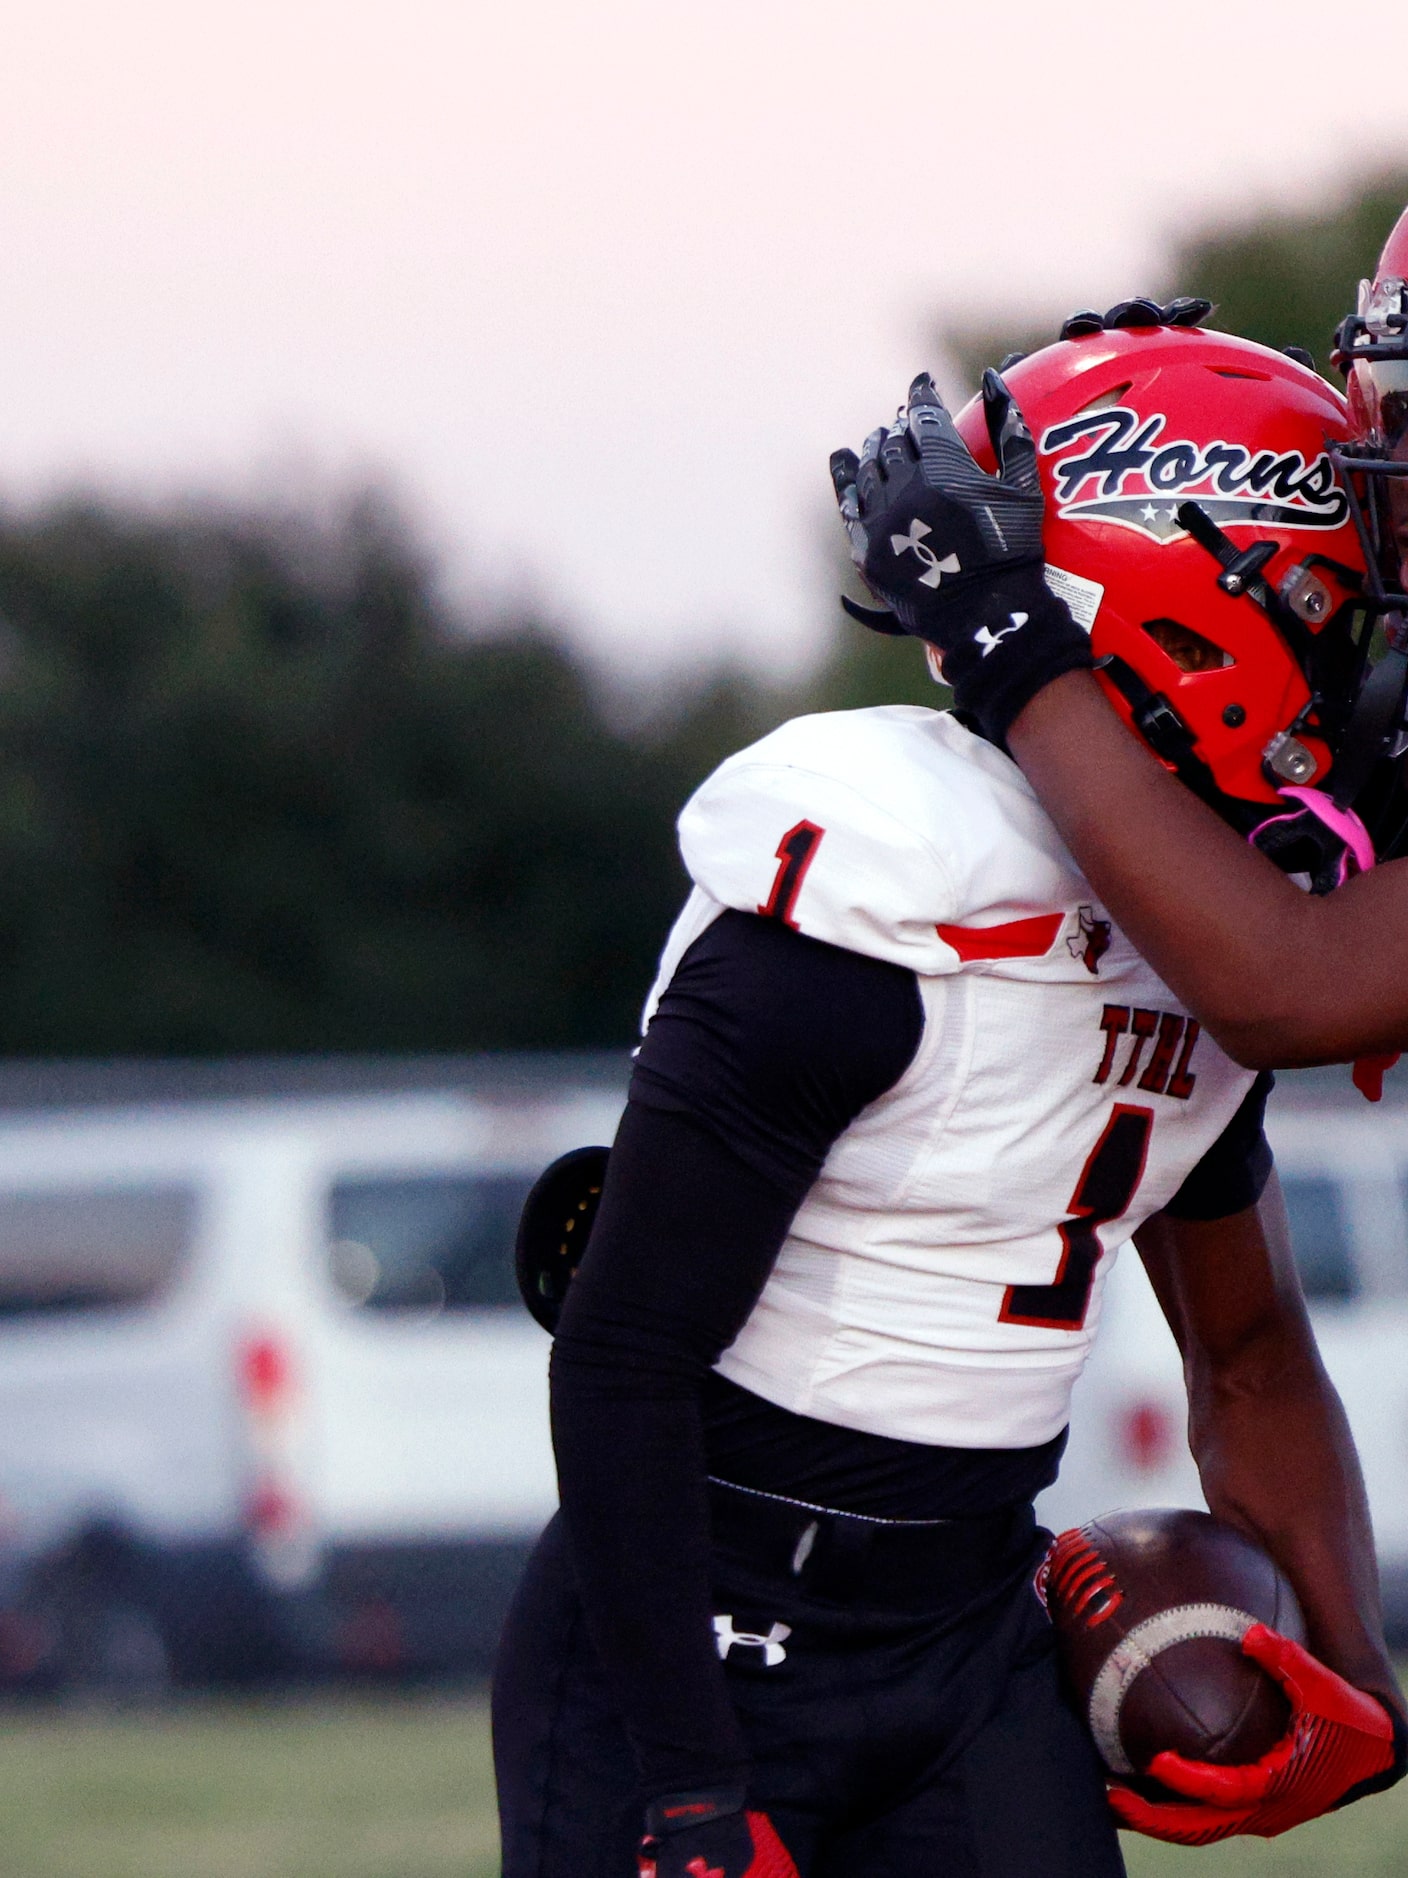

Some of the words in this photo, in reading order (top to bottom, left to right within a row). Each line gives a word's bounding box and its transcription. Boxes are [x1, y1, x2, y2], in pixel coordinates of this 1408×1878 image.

[1039, 406, 1348, 506] Horns
[757, 818, 826, 930] 1
[1092, 1003, 1201, 1100] TTHL
[998, 1102, 1155, 1331] 1
